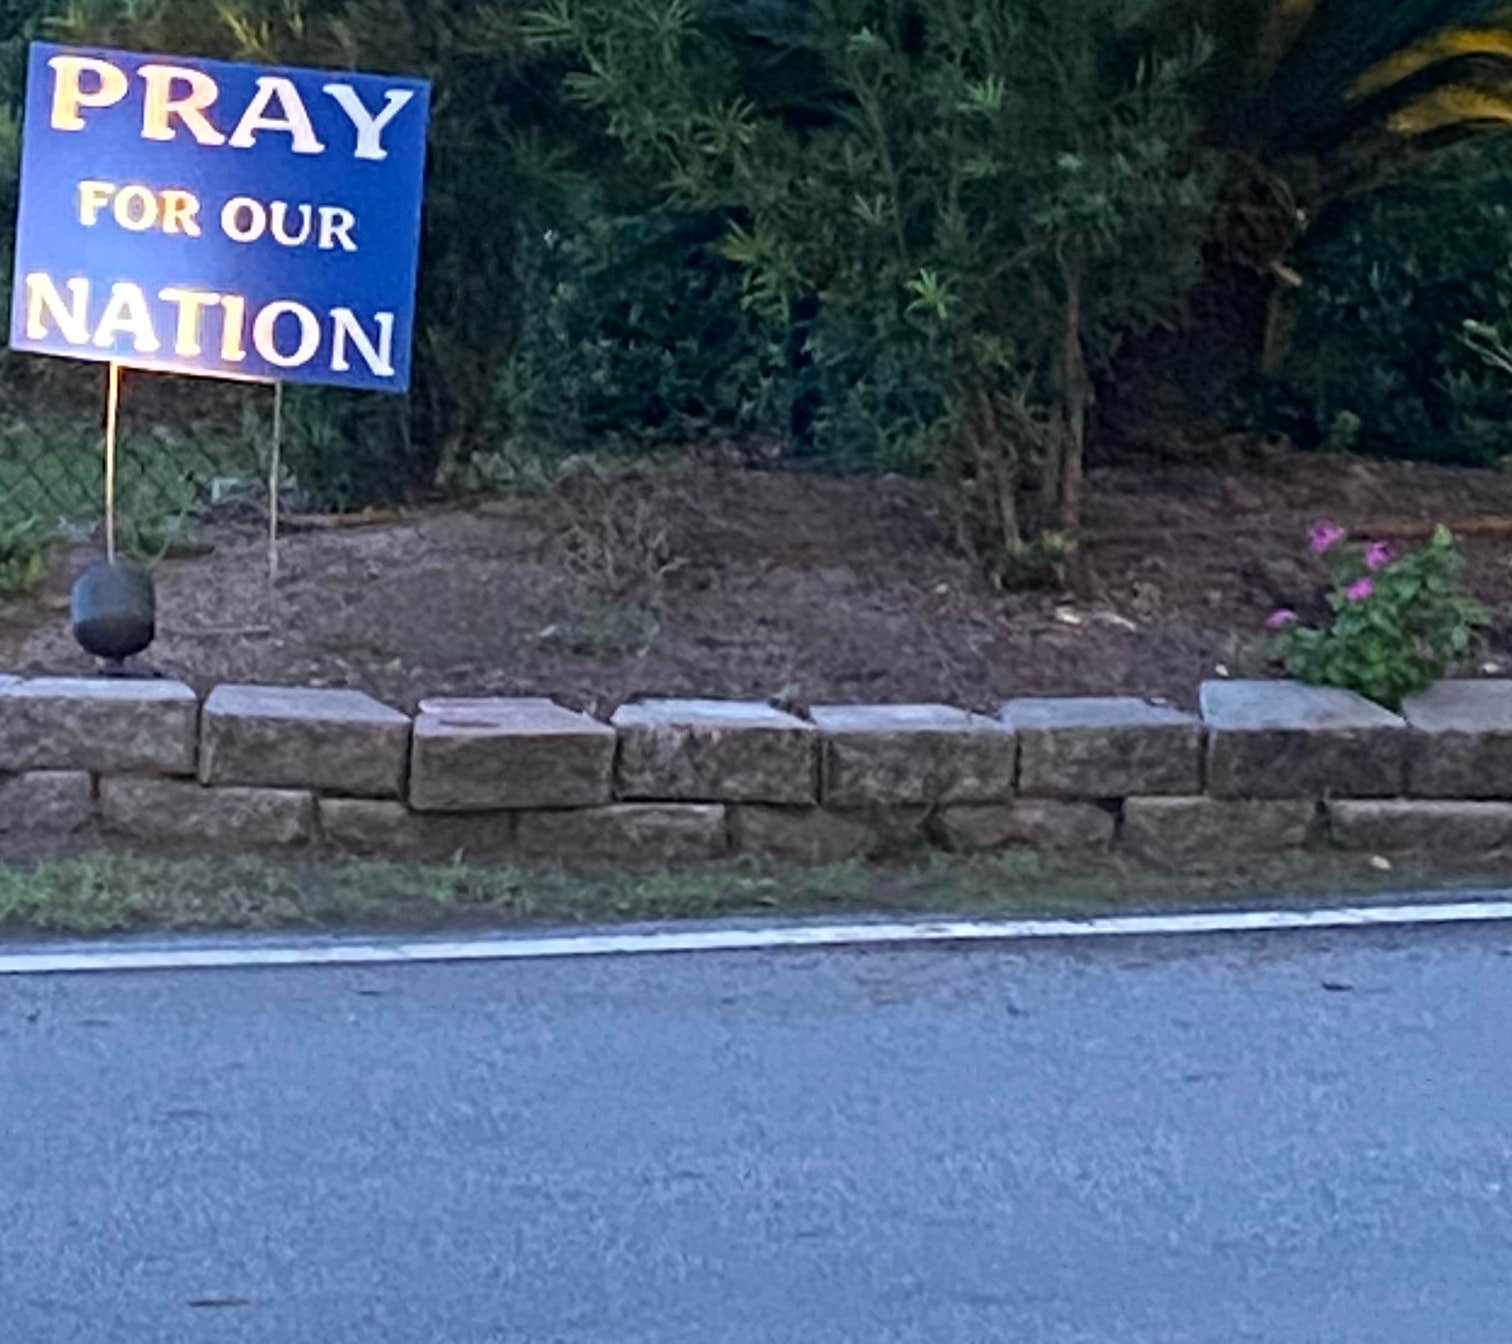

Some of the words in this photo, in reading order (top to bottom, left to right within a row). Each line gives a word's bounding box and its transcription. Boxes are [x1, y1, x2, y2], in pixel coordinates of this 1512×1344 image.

[47, 55, 414, 161] PRAY
[77, 180, 201, 238] FOR
[220, 196, 358, 252] OUR
[24, 271, 395, 378] NATION
